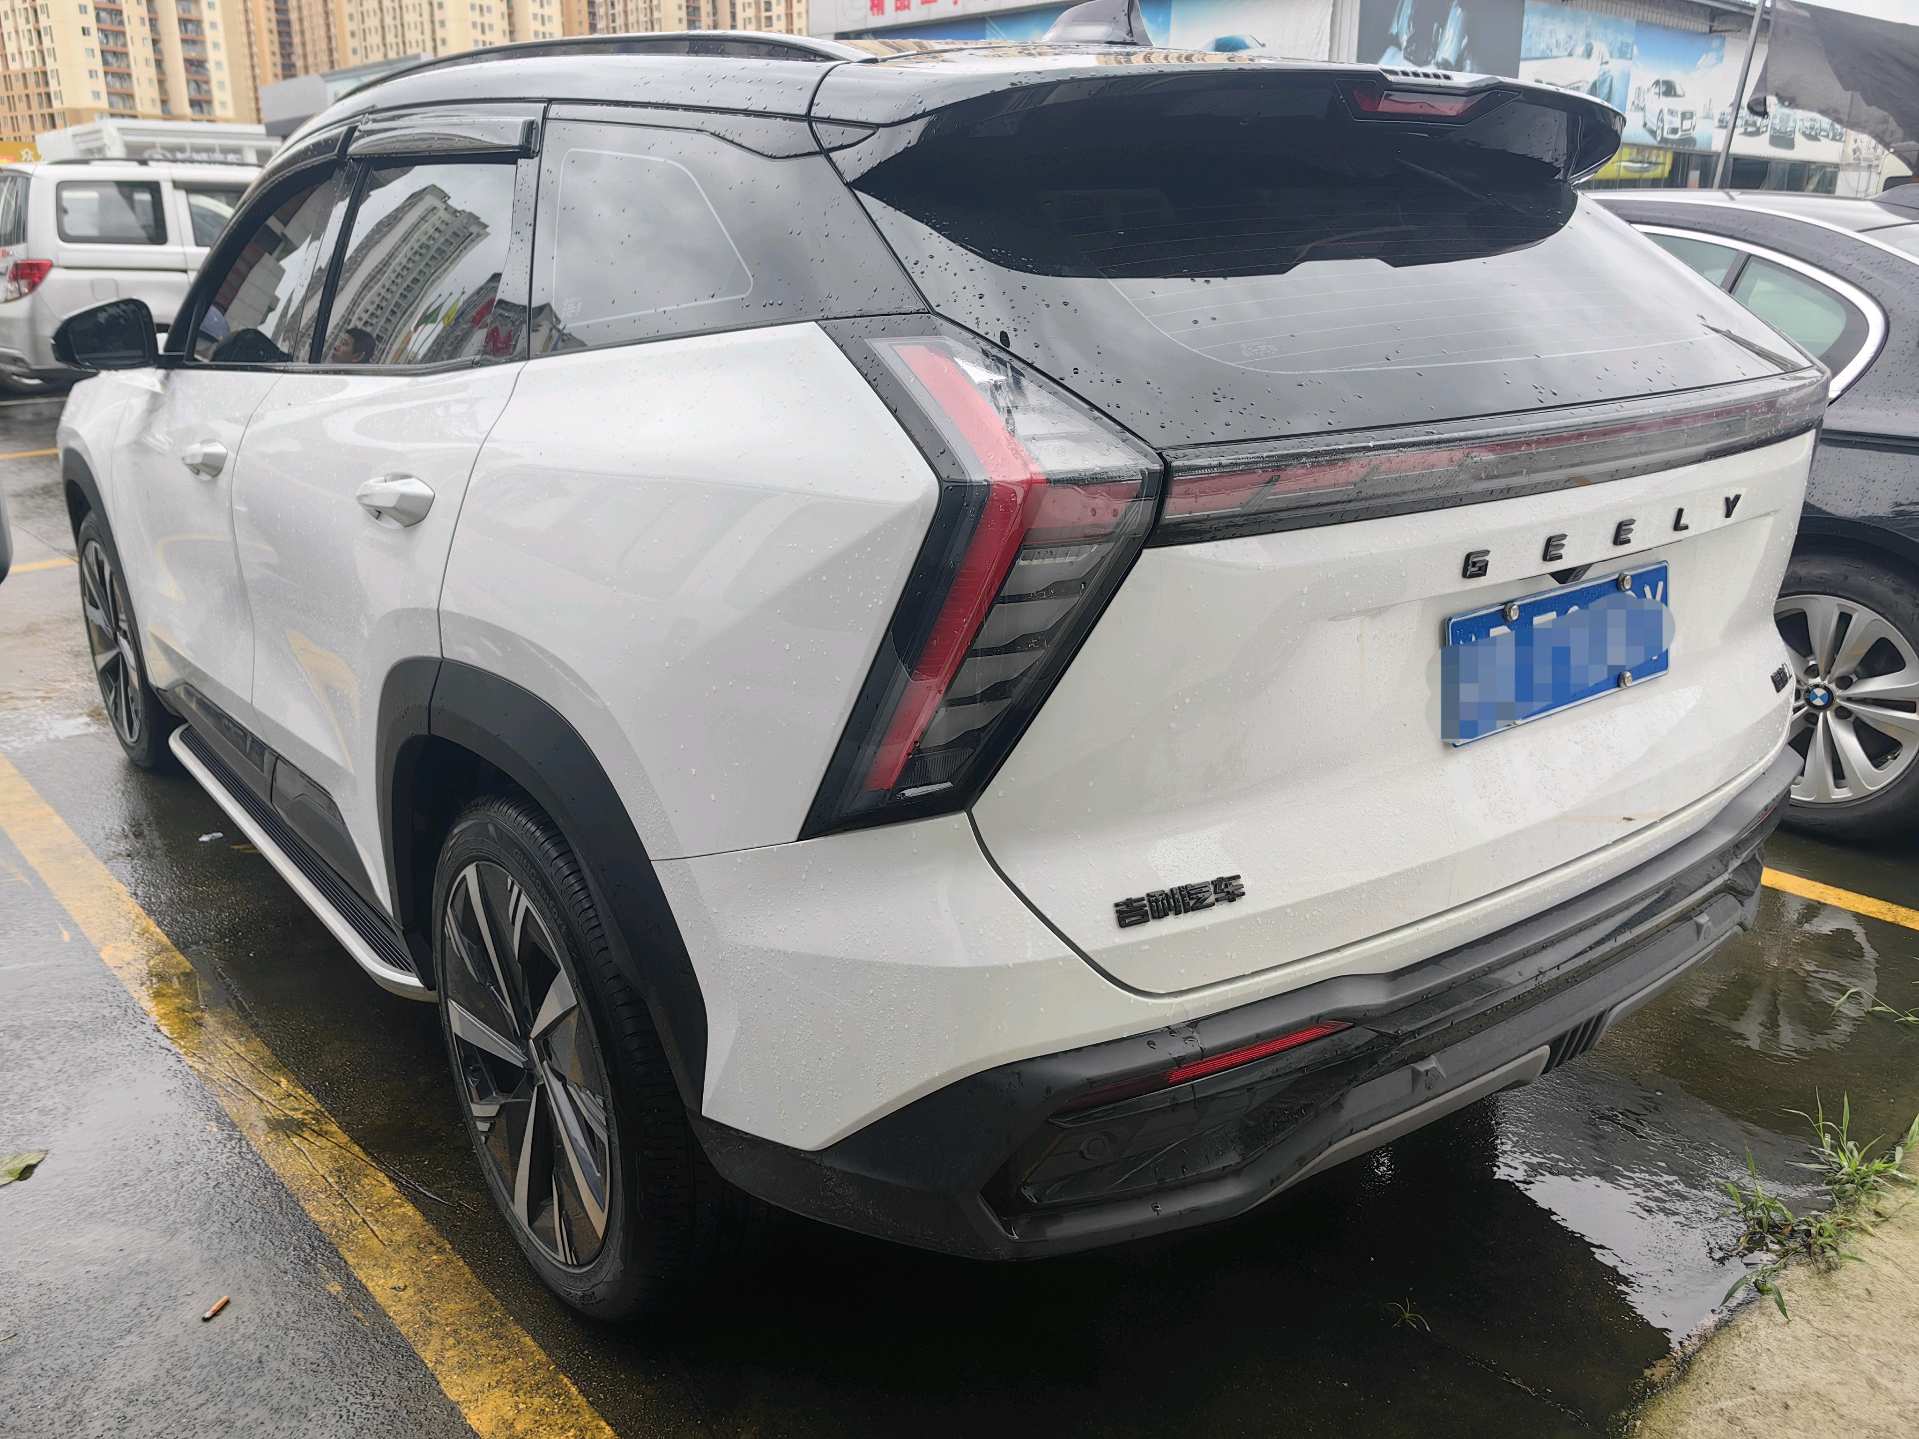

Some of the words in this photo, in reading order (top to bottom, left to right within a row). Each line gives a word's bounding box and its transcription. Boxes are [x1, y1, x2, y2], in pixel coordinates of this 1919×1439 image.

[1462, 494, 1741, 579] GEELY
[1113, 874, 1246, 928] 吉利汽车
